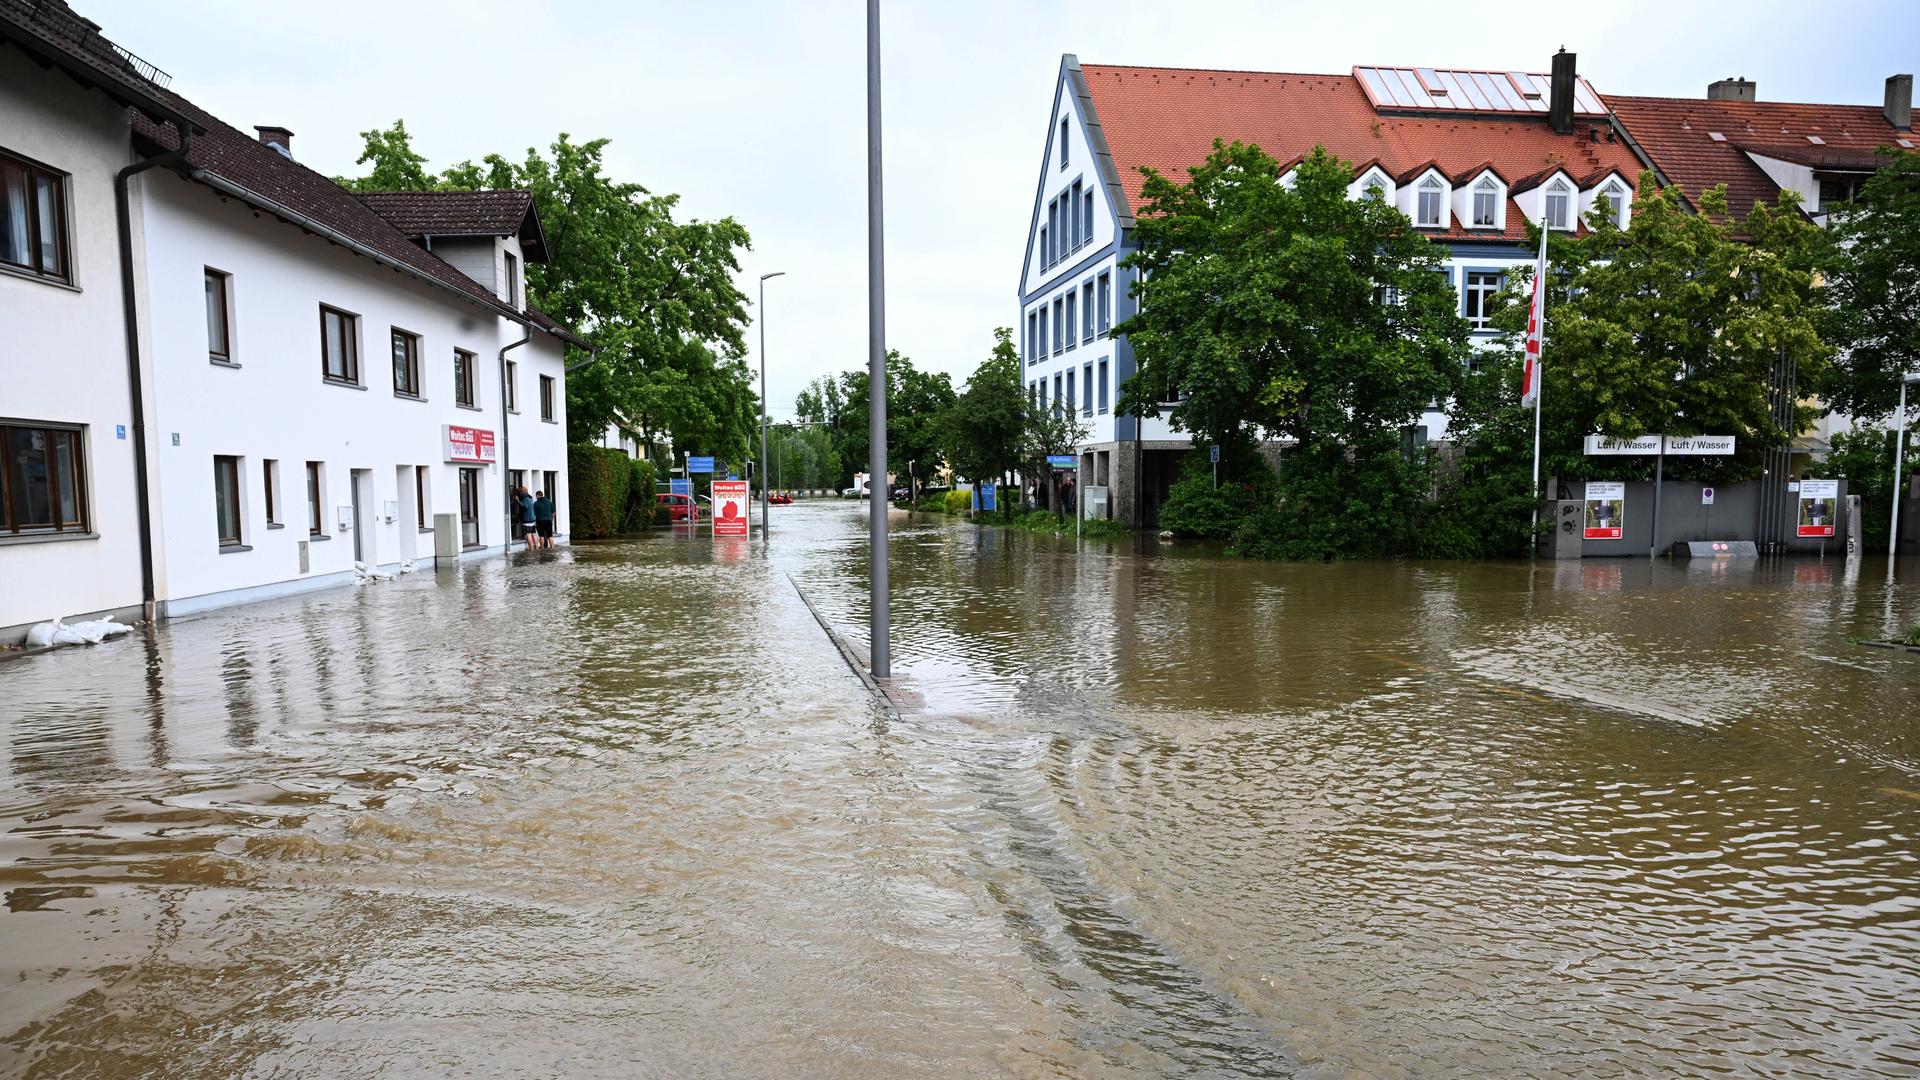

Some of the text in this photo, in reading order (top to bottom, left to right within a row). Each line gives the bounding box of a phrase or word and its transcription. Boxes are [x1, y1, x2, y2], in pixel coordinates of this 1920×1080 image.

[1597, 441, 1657, 451] Luft / Wasser
[1671, 441, 1730, 451] Luft / Wasser
